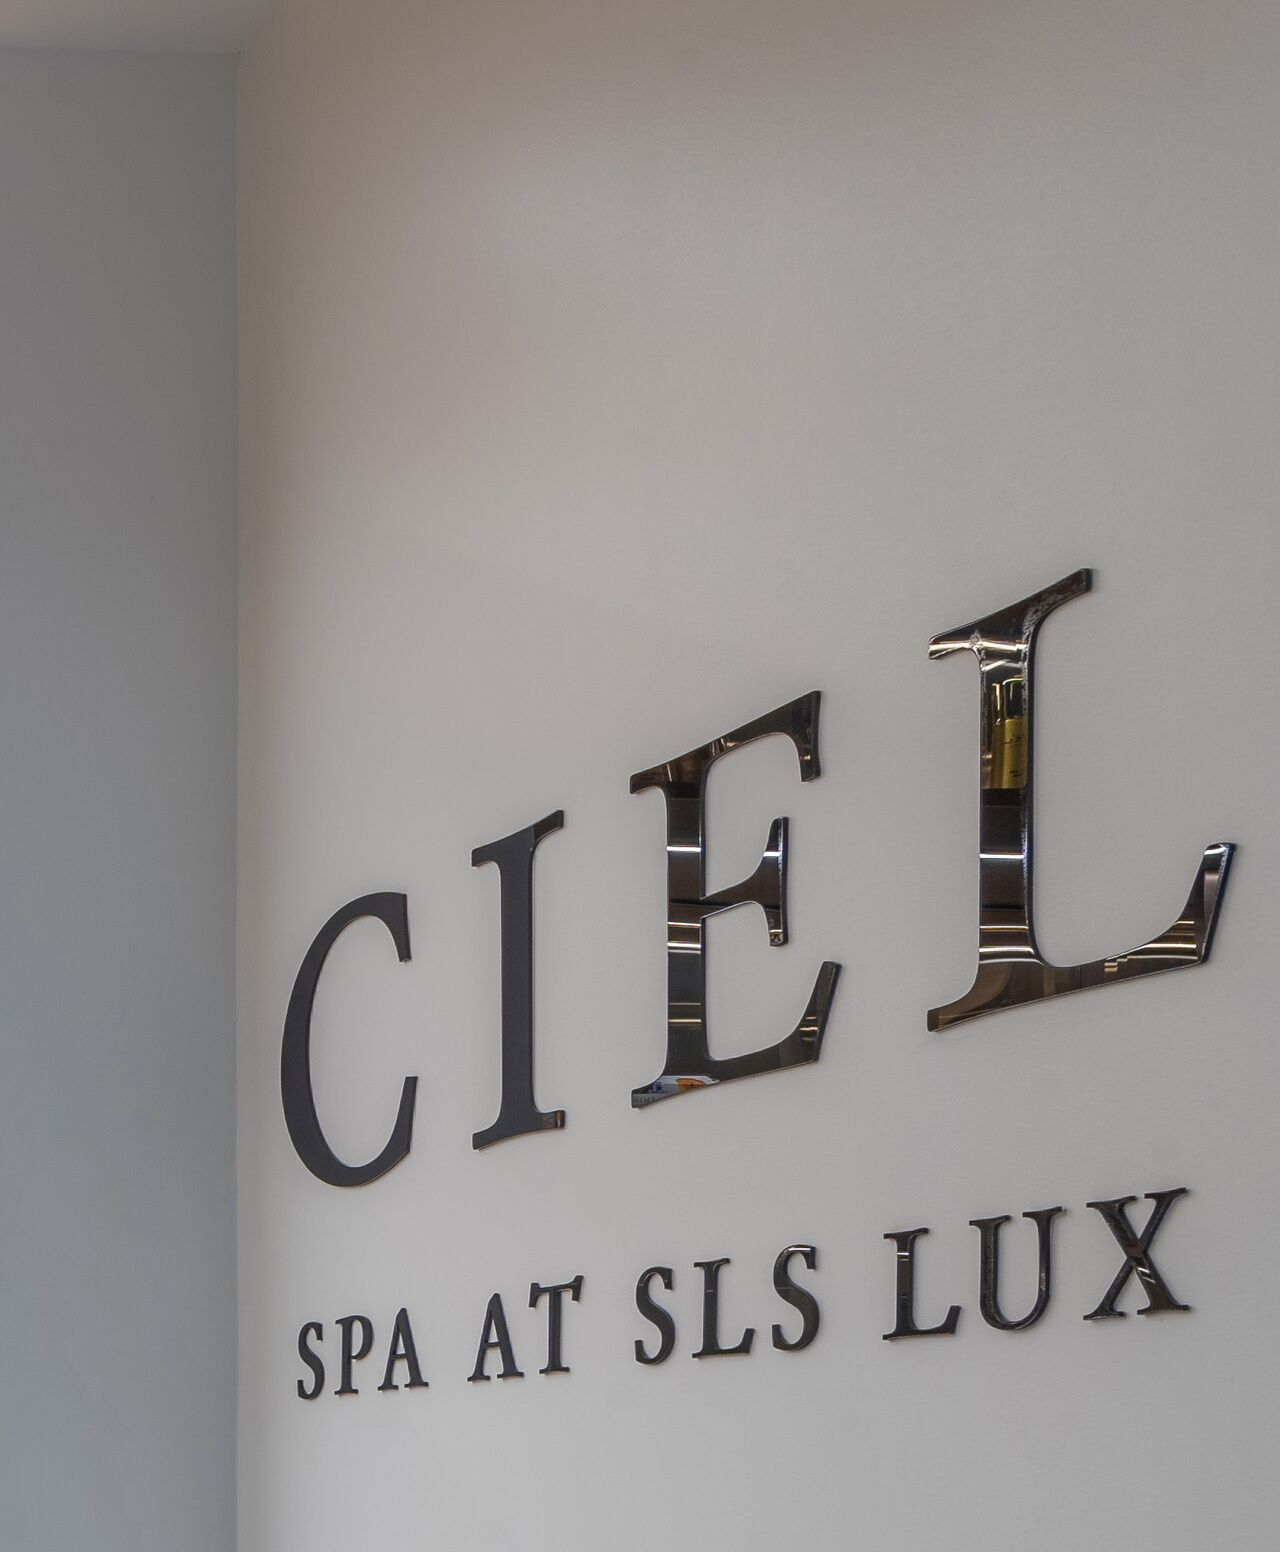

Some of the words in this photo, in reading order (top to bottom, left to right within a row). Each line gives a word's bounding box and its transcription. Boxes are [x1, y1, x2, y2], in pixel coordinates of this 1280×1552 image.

[280, 567, 1237, 1189] CIEL
[296, 1306, 430, 1401] SPA
[466, 1275, 585, 1383] AT
[633, 1243, 822, 1366] SLS
[882, 1186, 1192, 1344] LUX
